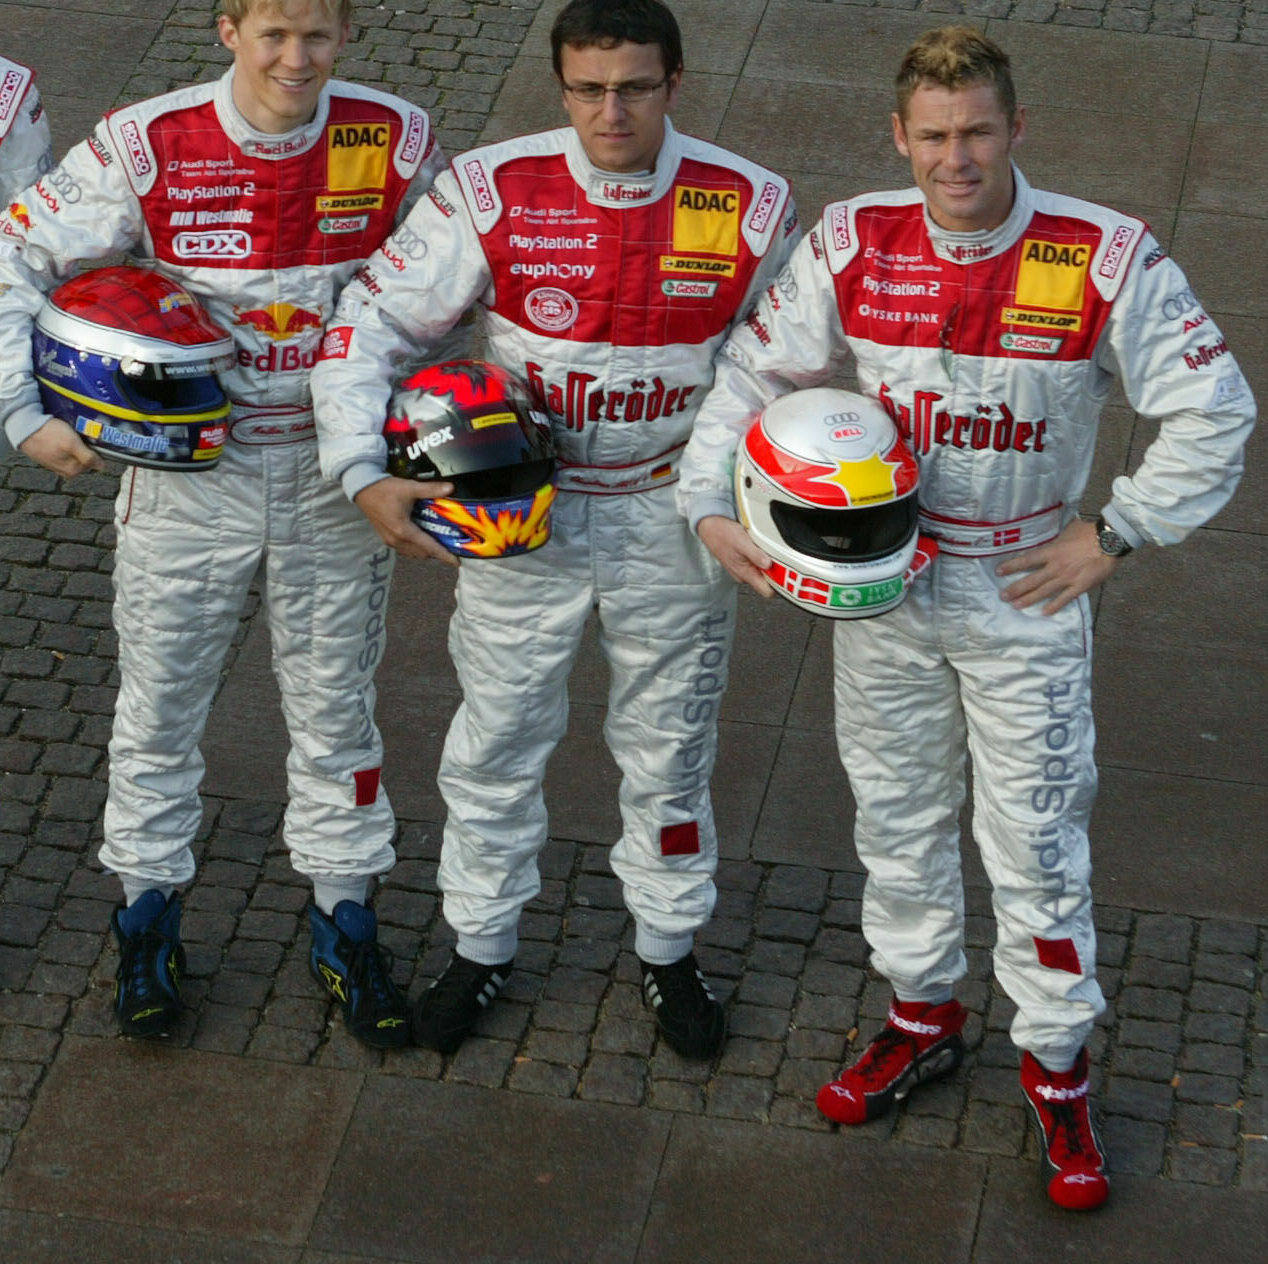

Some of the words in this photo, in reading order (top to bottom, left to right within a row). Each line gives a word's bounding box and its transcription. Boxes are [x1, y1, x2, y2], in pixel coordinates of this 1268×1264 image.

[123, 120, 151, 175] sparco
[331, 127, 388, 148] ADAC
[401, 112, 424, 164] sparco
[167, 184, 241, 203] PlayStation
[243, 182, 255, 196] 2
[466, 160, 494, 213] sparco
[329, 196, 381, 209] DUNLOP
[677, 191, 738, 213] ADAC
[749, 182, 779, 234] sparco
[331, 218, 363, 231] Castrol
[178, 235, 245, 254] CDX
[509, 234, 582, 252] PlayStation
[586, 232, 598, 249] 2
[1100, 226, 1132, 278] sparco
[675, 259, 732, 273] DUNLOP
[1025, 243, 1087, 268] ADAC
[509, 262, 596, 279] euphony
[675, 281, 710, 296] Castrol
[928, 281, 941, 297] 2
[904, 311, 940, 324] BANK
[1016, 313, 1078, 328] DUNLOP
[1013, 337, 1055, 351] Castrol
[280, 344, 317, 371] Bu
[101, 424, 170, 454] Westmatic
[406, 426, 455, 460] uvex
[834, 427, 863, 439] BELL
[682, 610, 728, 725] Sport
[1030, 680, 1075, 815] Sport
